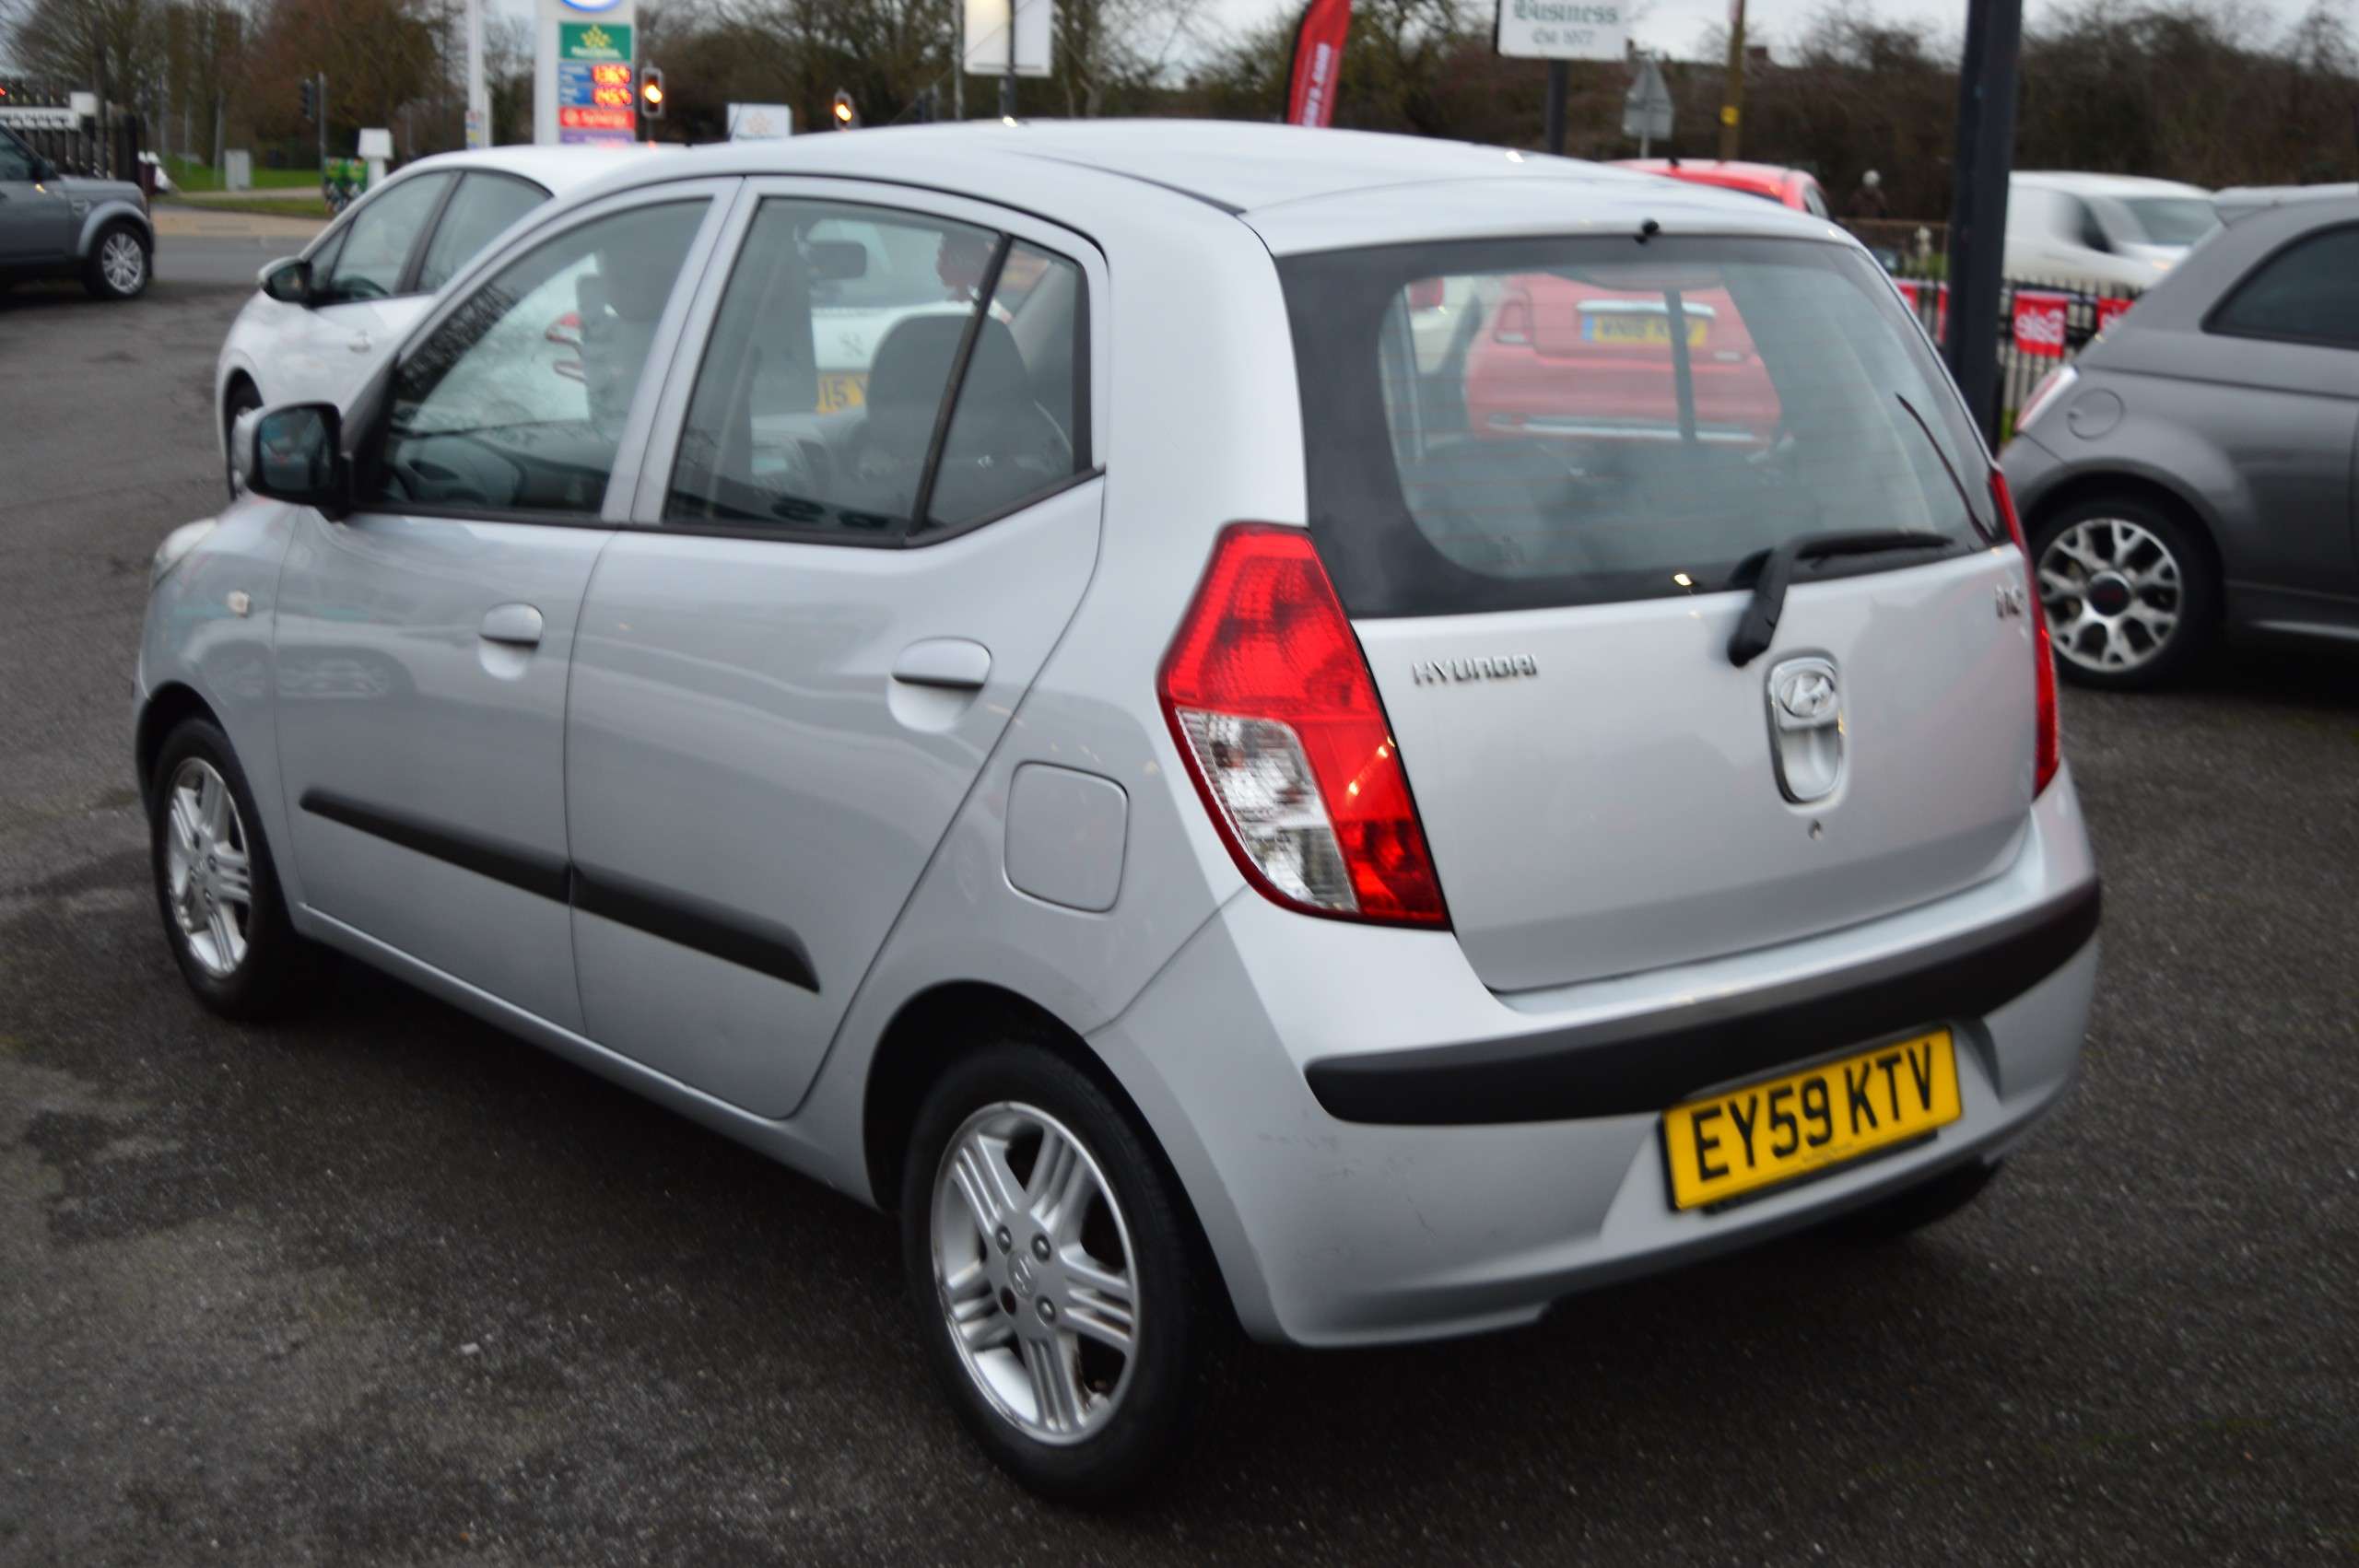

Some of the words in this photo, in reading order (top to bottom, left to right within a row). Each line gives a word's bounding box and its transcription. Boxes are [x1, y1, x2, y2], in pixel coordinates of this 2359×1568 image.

[1412, 653, 1538, 686] HYUNDAI
[1690, 1075, 1833, 1182] EY59
[1844, 1041, 1931, 1136] KTV
